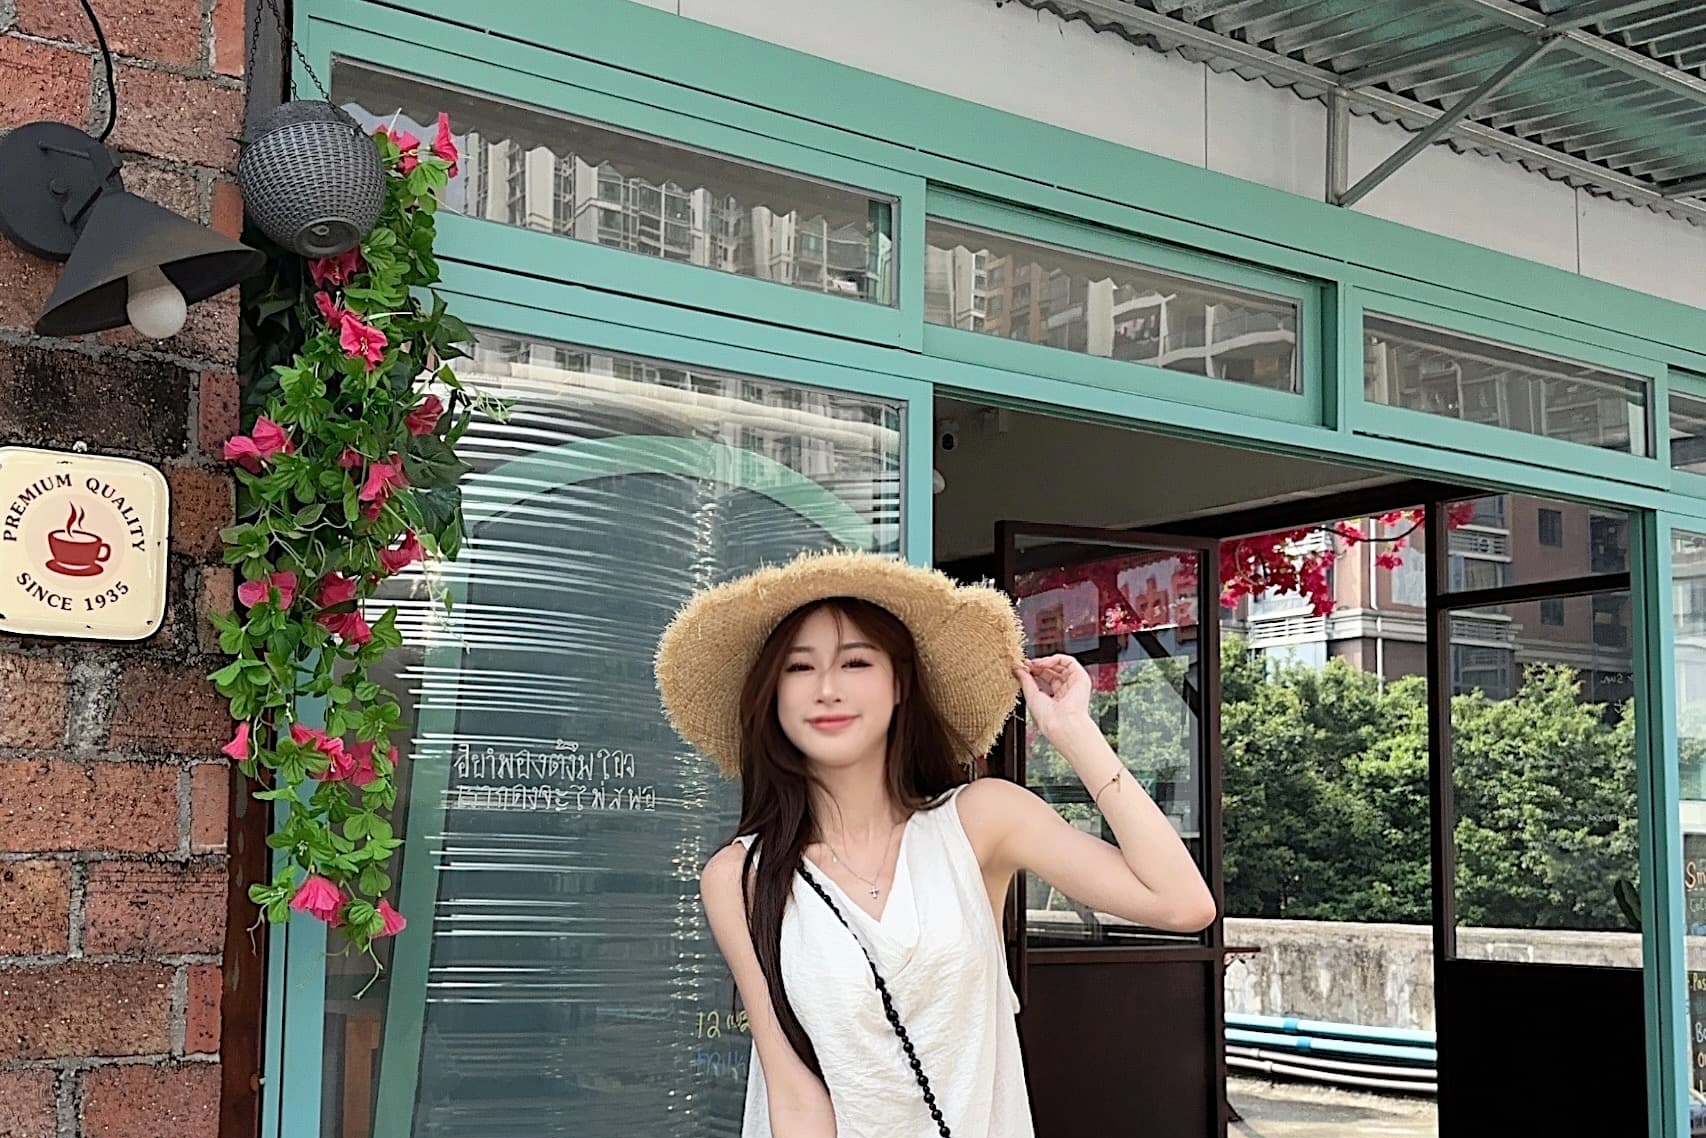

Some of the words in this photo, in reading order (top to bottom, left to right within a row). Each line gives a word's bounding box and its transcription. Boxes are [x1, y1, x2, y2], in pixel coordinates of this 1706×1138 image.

[3, 473, 73, 543] PREMIUM
[85, 476, 146, 553] QUALITY
[16, 571, 73, 612] SINCE
[83, 580, 130, 612] 1935
